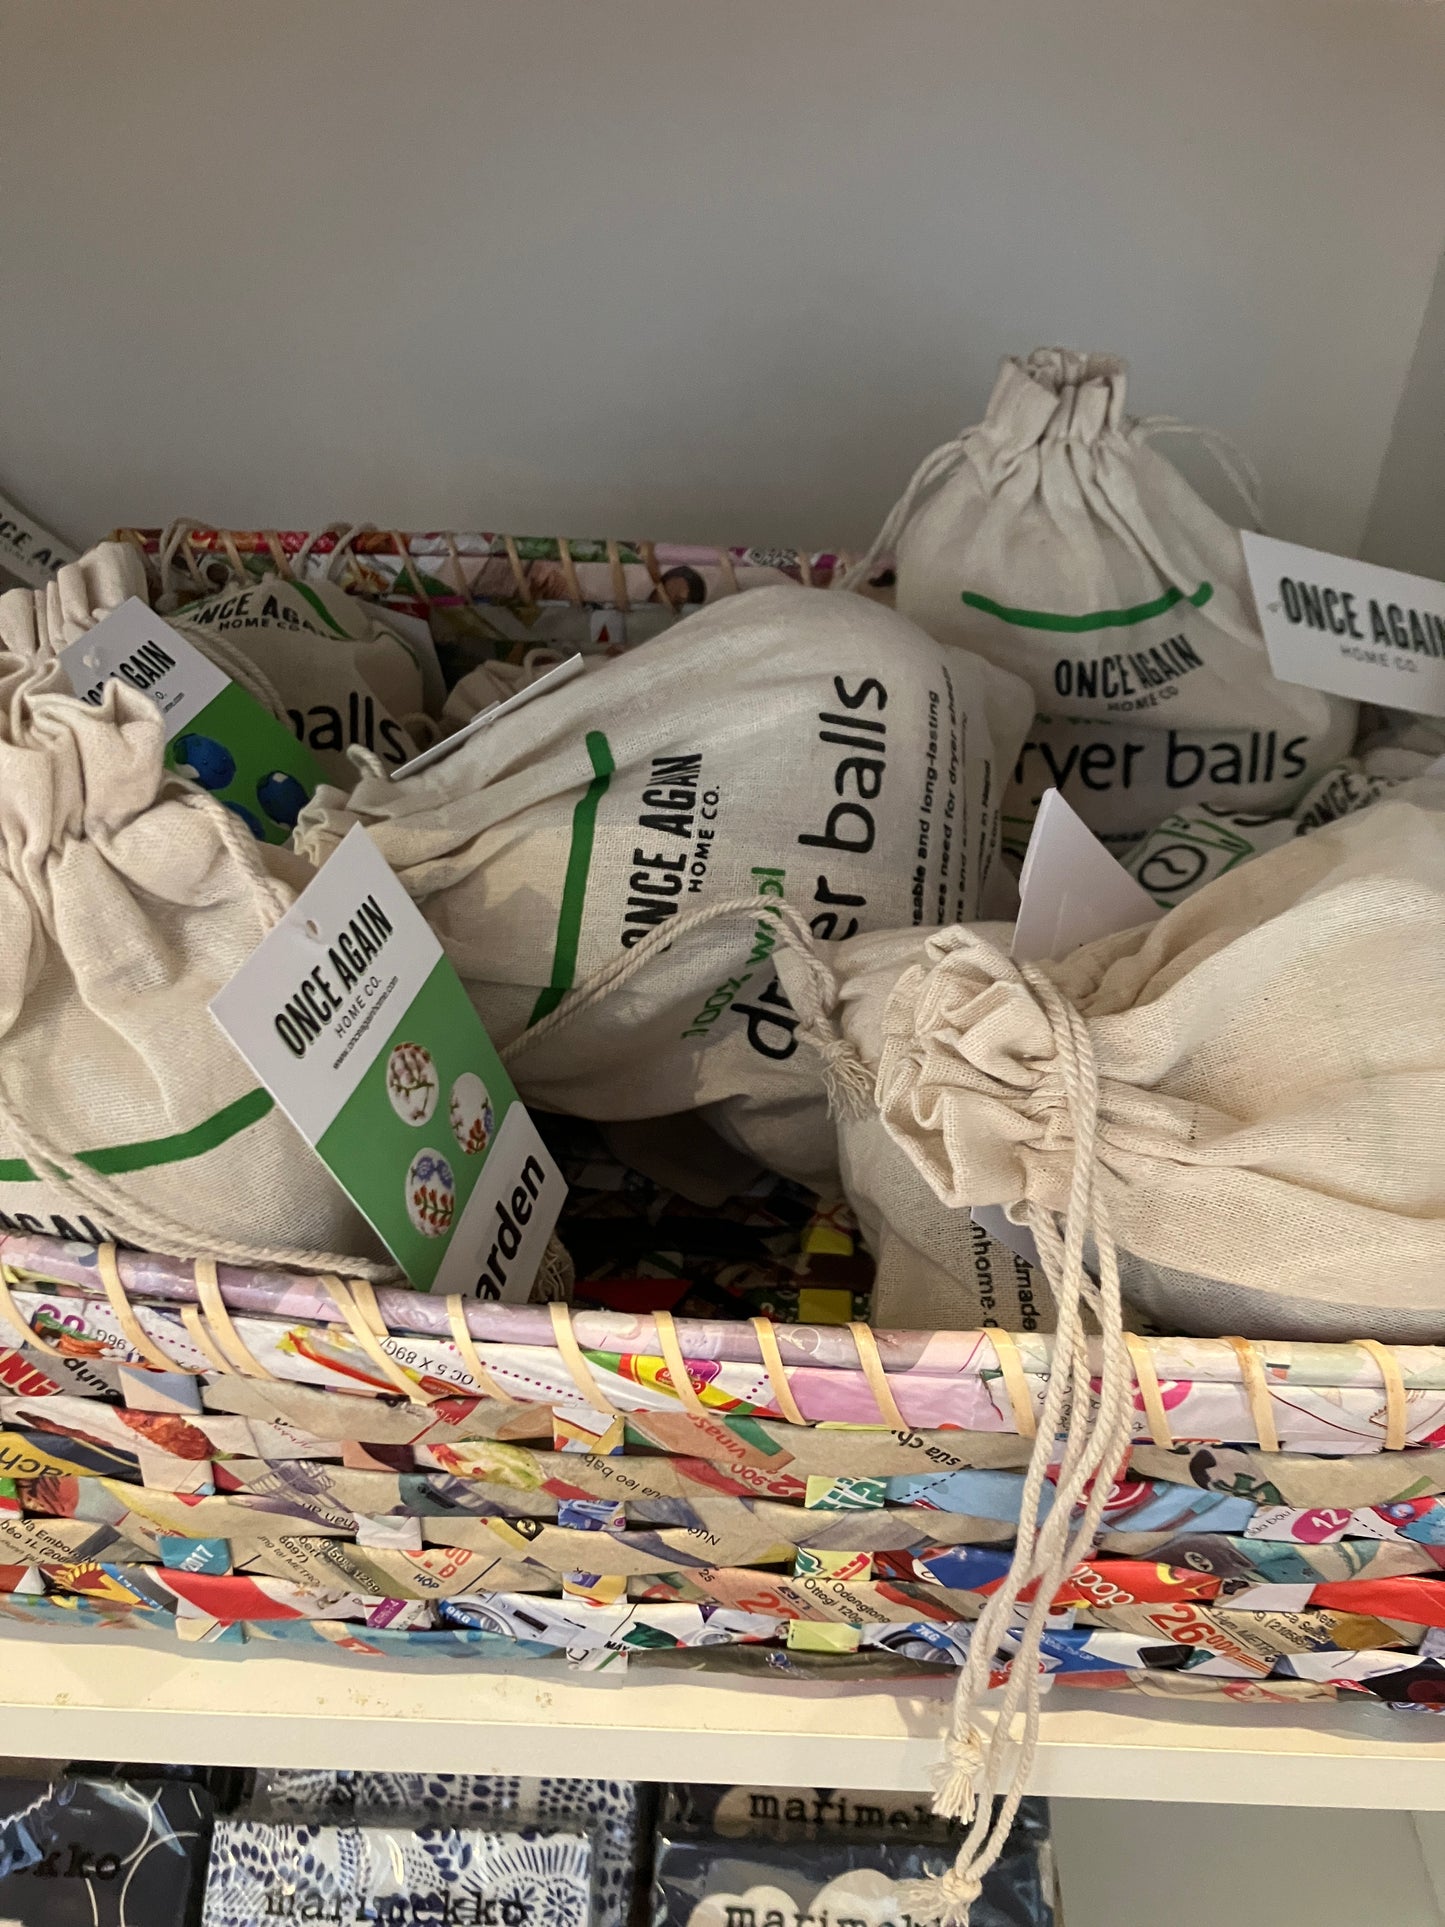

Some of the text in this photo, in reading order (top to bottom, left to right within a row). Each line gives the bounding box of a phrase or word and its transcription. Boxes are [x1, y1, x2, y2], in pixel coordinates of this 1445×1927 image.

[188, 592, 254, 626] NCE
[219, 616, 270, 632] HOME
[1280, 576, 1364, 640] ONCE
[110, 640, 176, 690] GAIN
[1054, 633, 1204, 698] ONCE AGAIN
[921, 690, 940, 814] long-lasting
[948, 729, 959, 785] dryer
[1014, 742, 1145, 805] ryer
[1166, 730, 1309, 790] balls
[944, 788, 955, 819] for
[688, 785, 720, 892] HOME CO.
[918, 819, 930, 859] and
[941, 824, 952, 876] need
[731, 675, 888, 1060] drer balls
[275, 894, 393, 1057] ONCE AGAIN
[335, 976, 382, 1038] HOME CO.
[463, 1155, 546, 1300] arden
[580, 1453, 614, 1478] bab
[616, 1472, 643, 1490] leo
[1311, 1508, 1349, 1529] 12
[698, 1569, 715, 1583] 25
[804, 1578, 835, 1607] Ottogi
[915, 1624, 941, 1643] 7KG
[265, 1889, 527, 1926] marimekko
